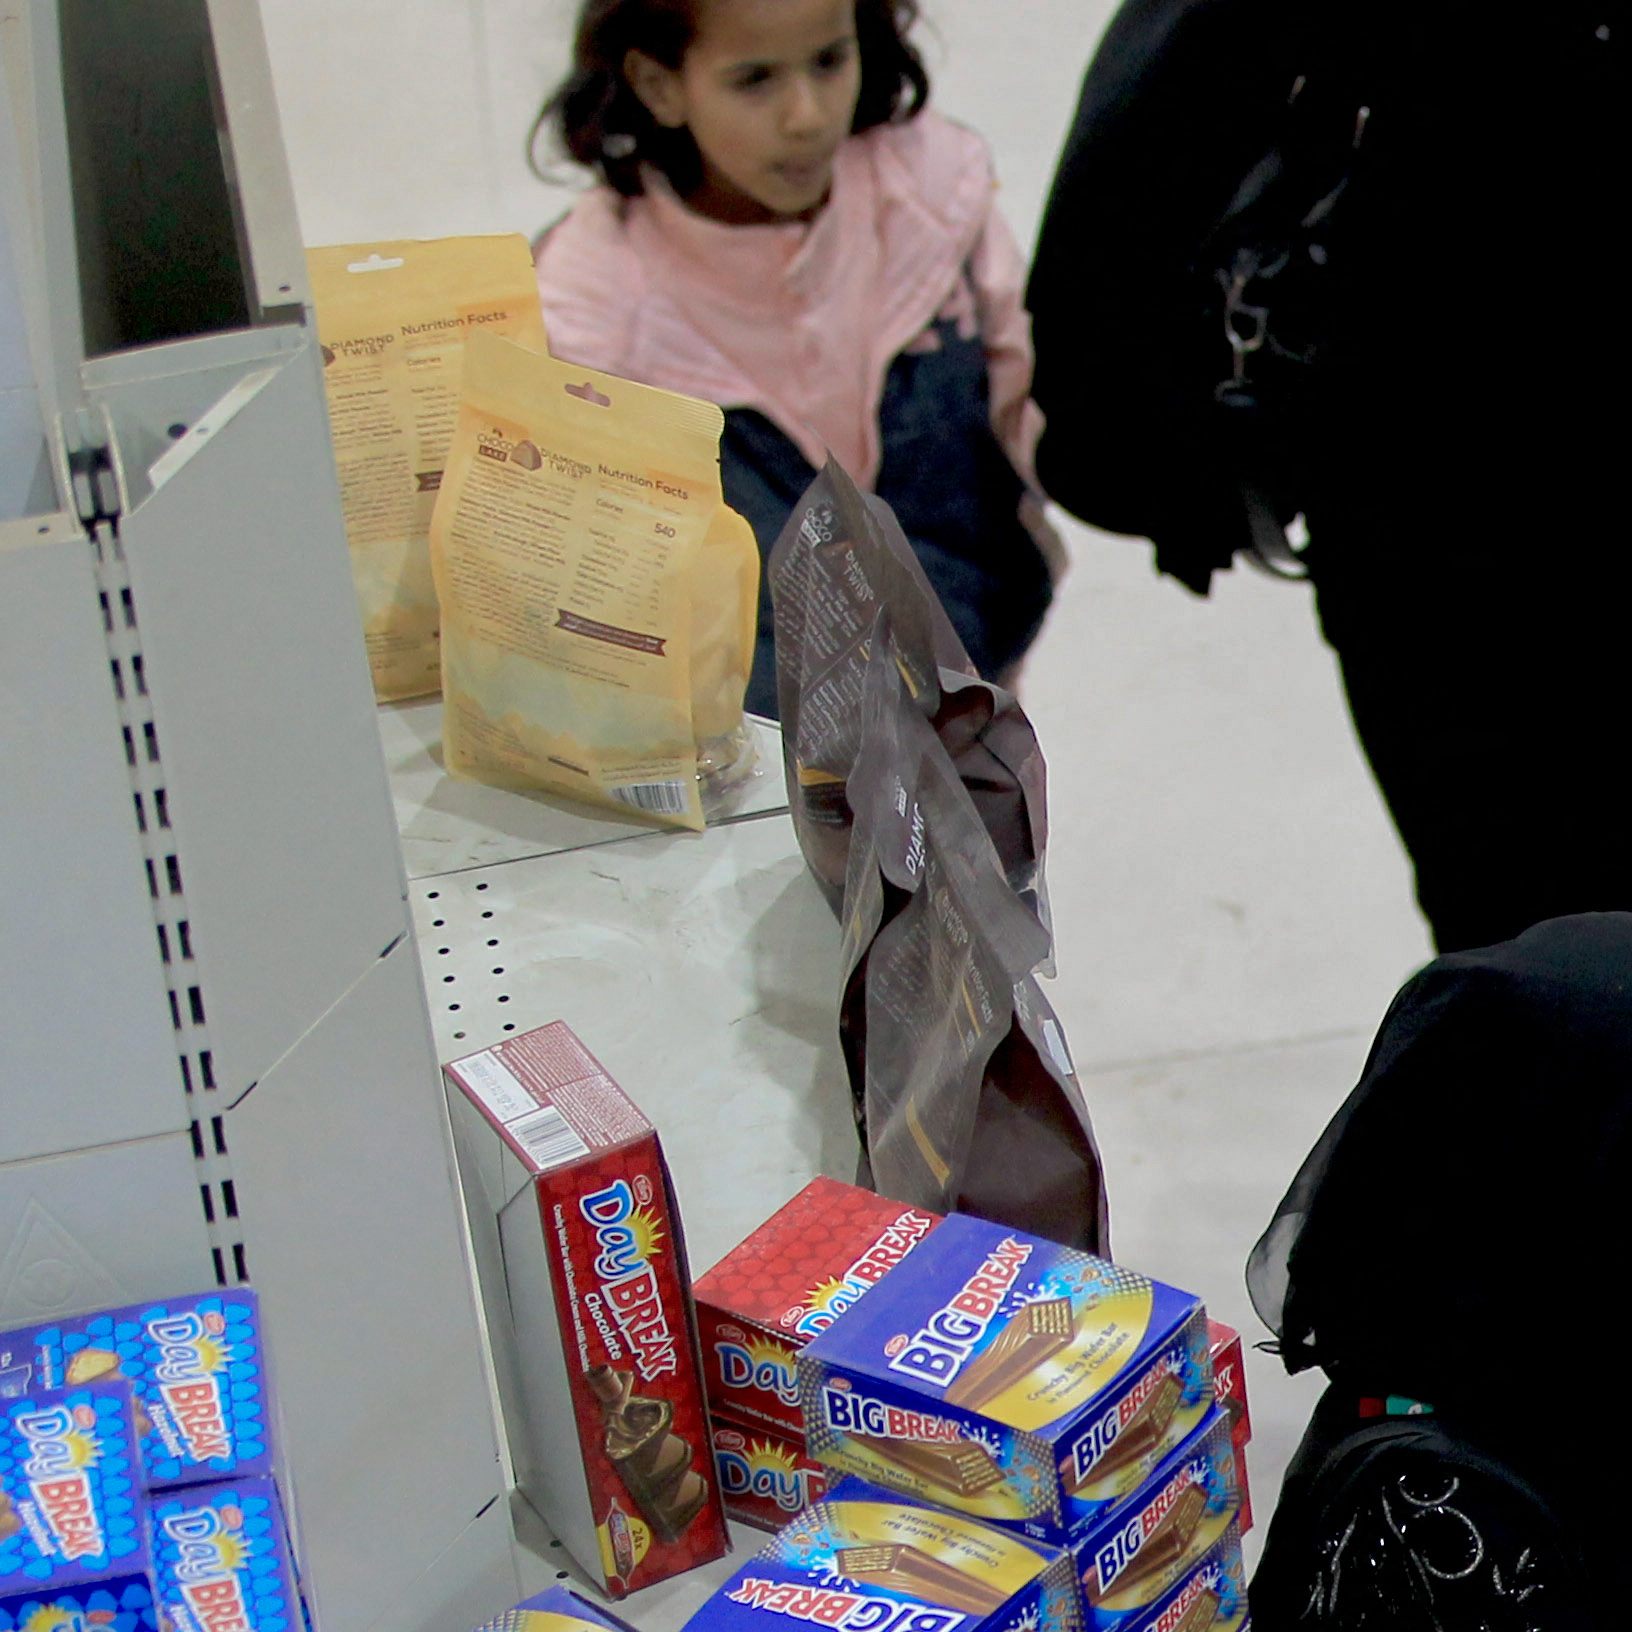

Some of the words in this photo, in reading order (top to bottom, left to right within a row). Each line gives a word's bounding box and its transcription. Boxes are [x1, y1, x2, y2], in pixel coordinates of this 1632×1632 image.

[330, 335, 394, 349] DIAMOND
[342, 346, 384, 356] TWIST
[401, 318, 465, 335] Nutrition
[468, 311, 507, 325] Facts
[477, 433, 513, 451] CHOCO
[540, 448, 592, 474] DIAMOND
[599, 464, 654, 488] Nutrition
[656, 480, 688, 500] Facts
[654, 523, 676, 538] 540
[805, 507, 833, 543] CHOCO
[578, 1178, 646, 1281] Day
[583, 1292, 623, 1362] Chocolate
[602, 1265, 677, 1383] BREAK
[885, 1310, 978, 1387] BIG
[952, 1235, 1033, 1329] BREAK
[148, 1311, 219, 1384] Day
[716, 1341, 801, 1409] Day
[16, 1405, 89, 1481] Day
[158, 1378, 232, 1462] BREAK
[823, 1387, 888, 1437] BIG
[886, 1407, 975, 1445] BREAK
[1072, 1410, 1121, 1485] BIG
[1117, 1357, 1170, 1429] BREAK
[715, 1449, 803, 1505] Day
[28, 1470, 104, 1561] BREAK
[163, 1506, 237, 1582] Day
[631, 1525, 644, 1551] 24x
[1095, 1519, 1143, 1593] BIG
[1140, 1468, 1195, 1538] BREAK
[728, 1578, 862, 1629] BREAK
